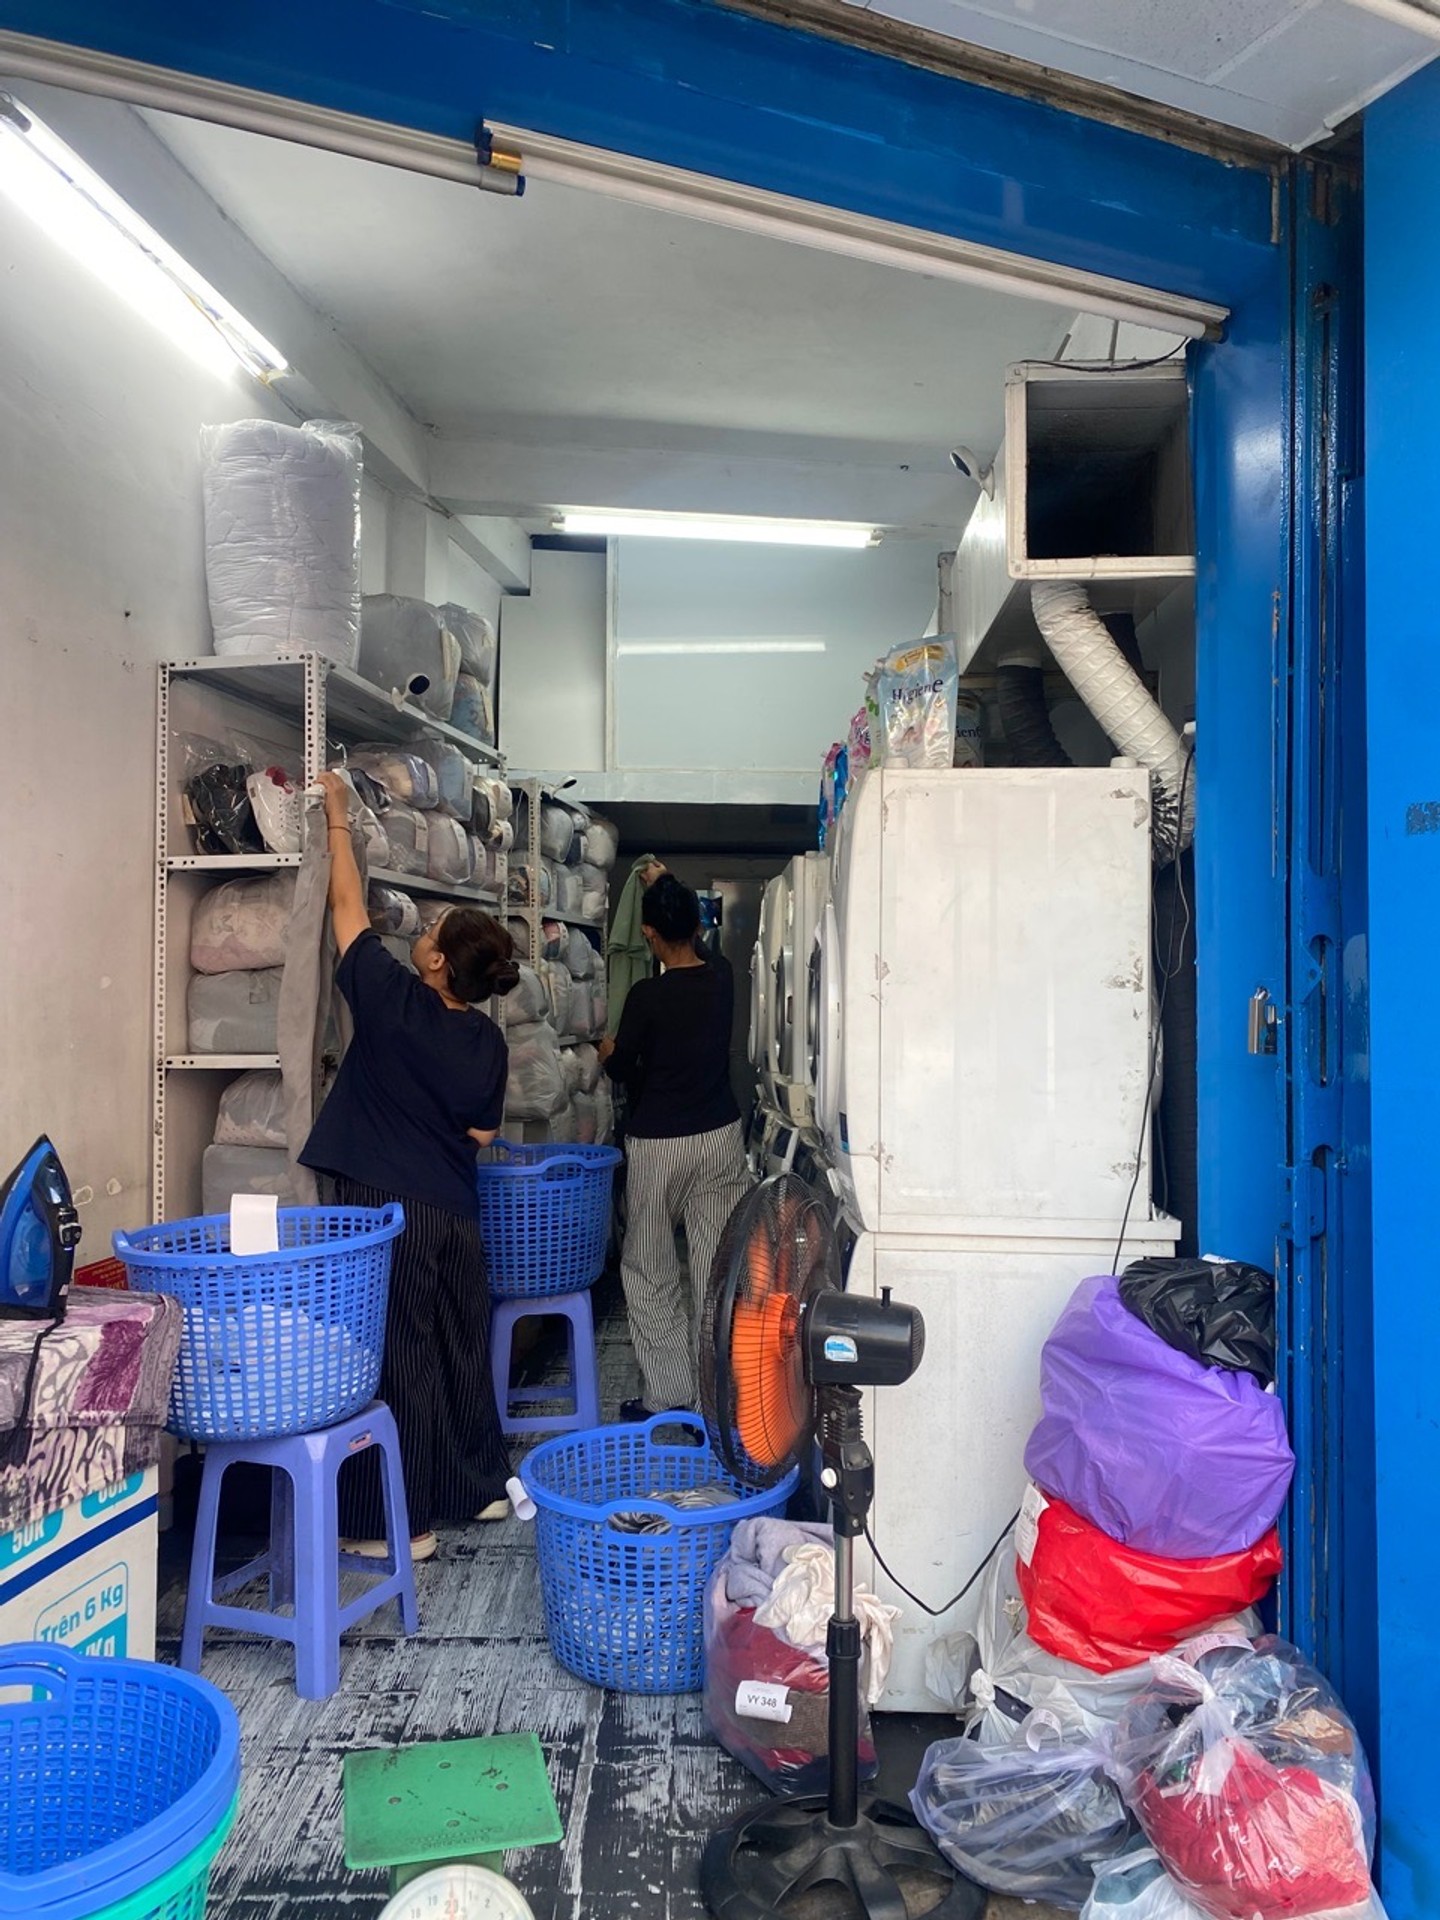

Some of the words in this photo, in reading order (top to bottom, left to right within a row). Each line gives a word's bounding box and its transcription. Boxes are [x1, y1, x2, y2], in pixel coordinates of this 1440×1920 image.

[892, 679, 944, 704] Hygiene
[40, 1611, 81, 1642] Trên
[84, 1596, 97, 1621] 6
[100, 1584, 124, 1612] Kg
[747, 1694, 760, 1704] VY
[760, 1696, 777, 1708] 348
